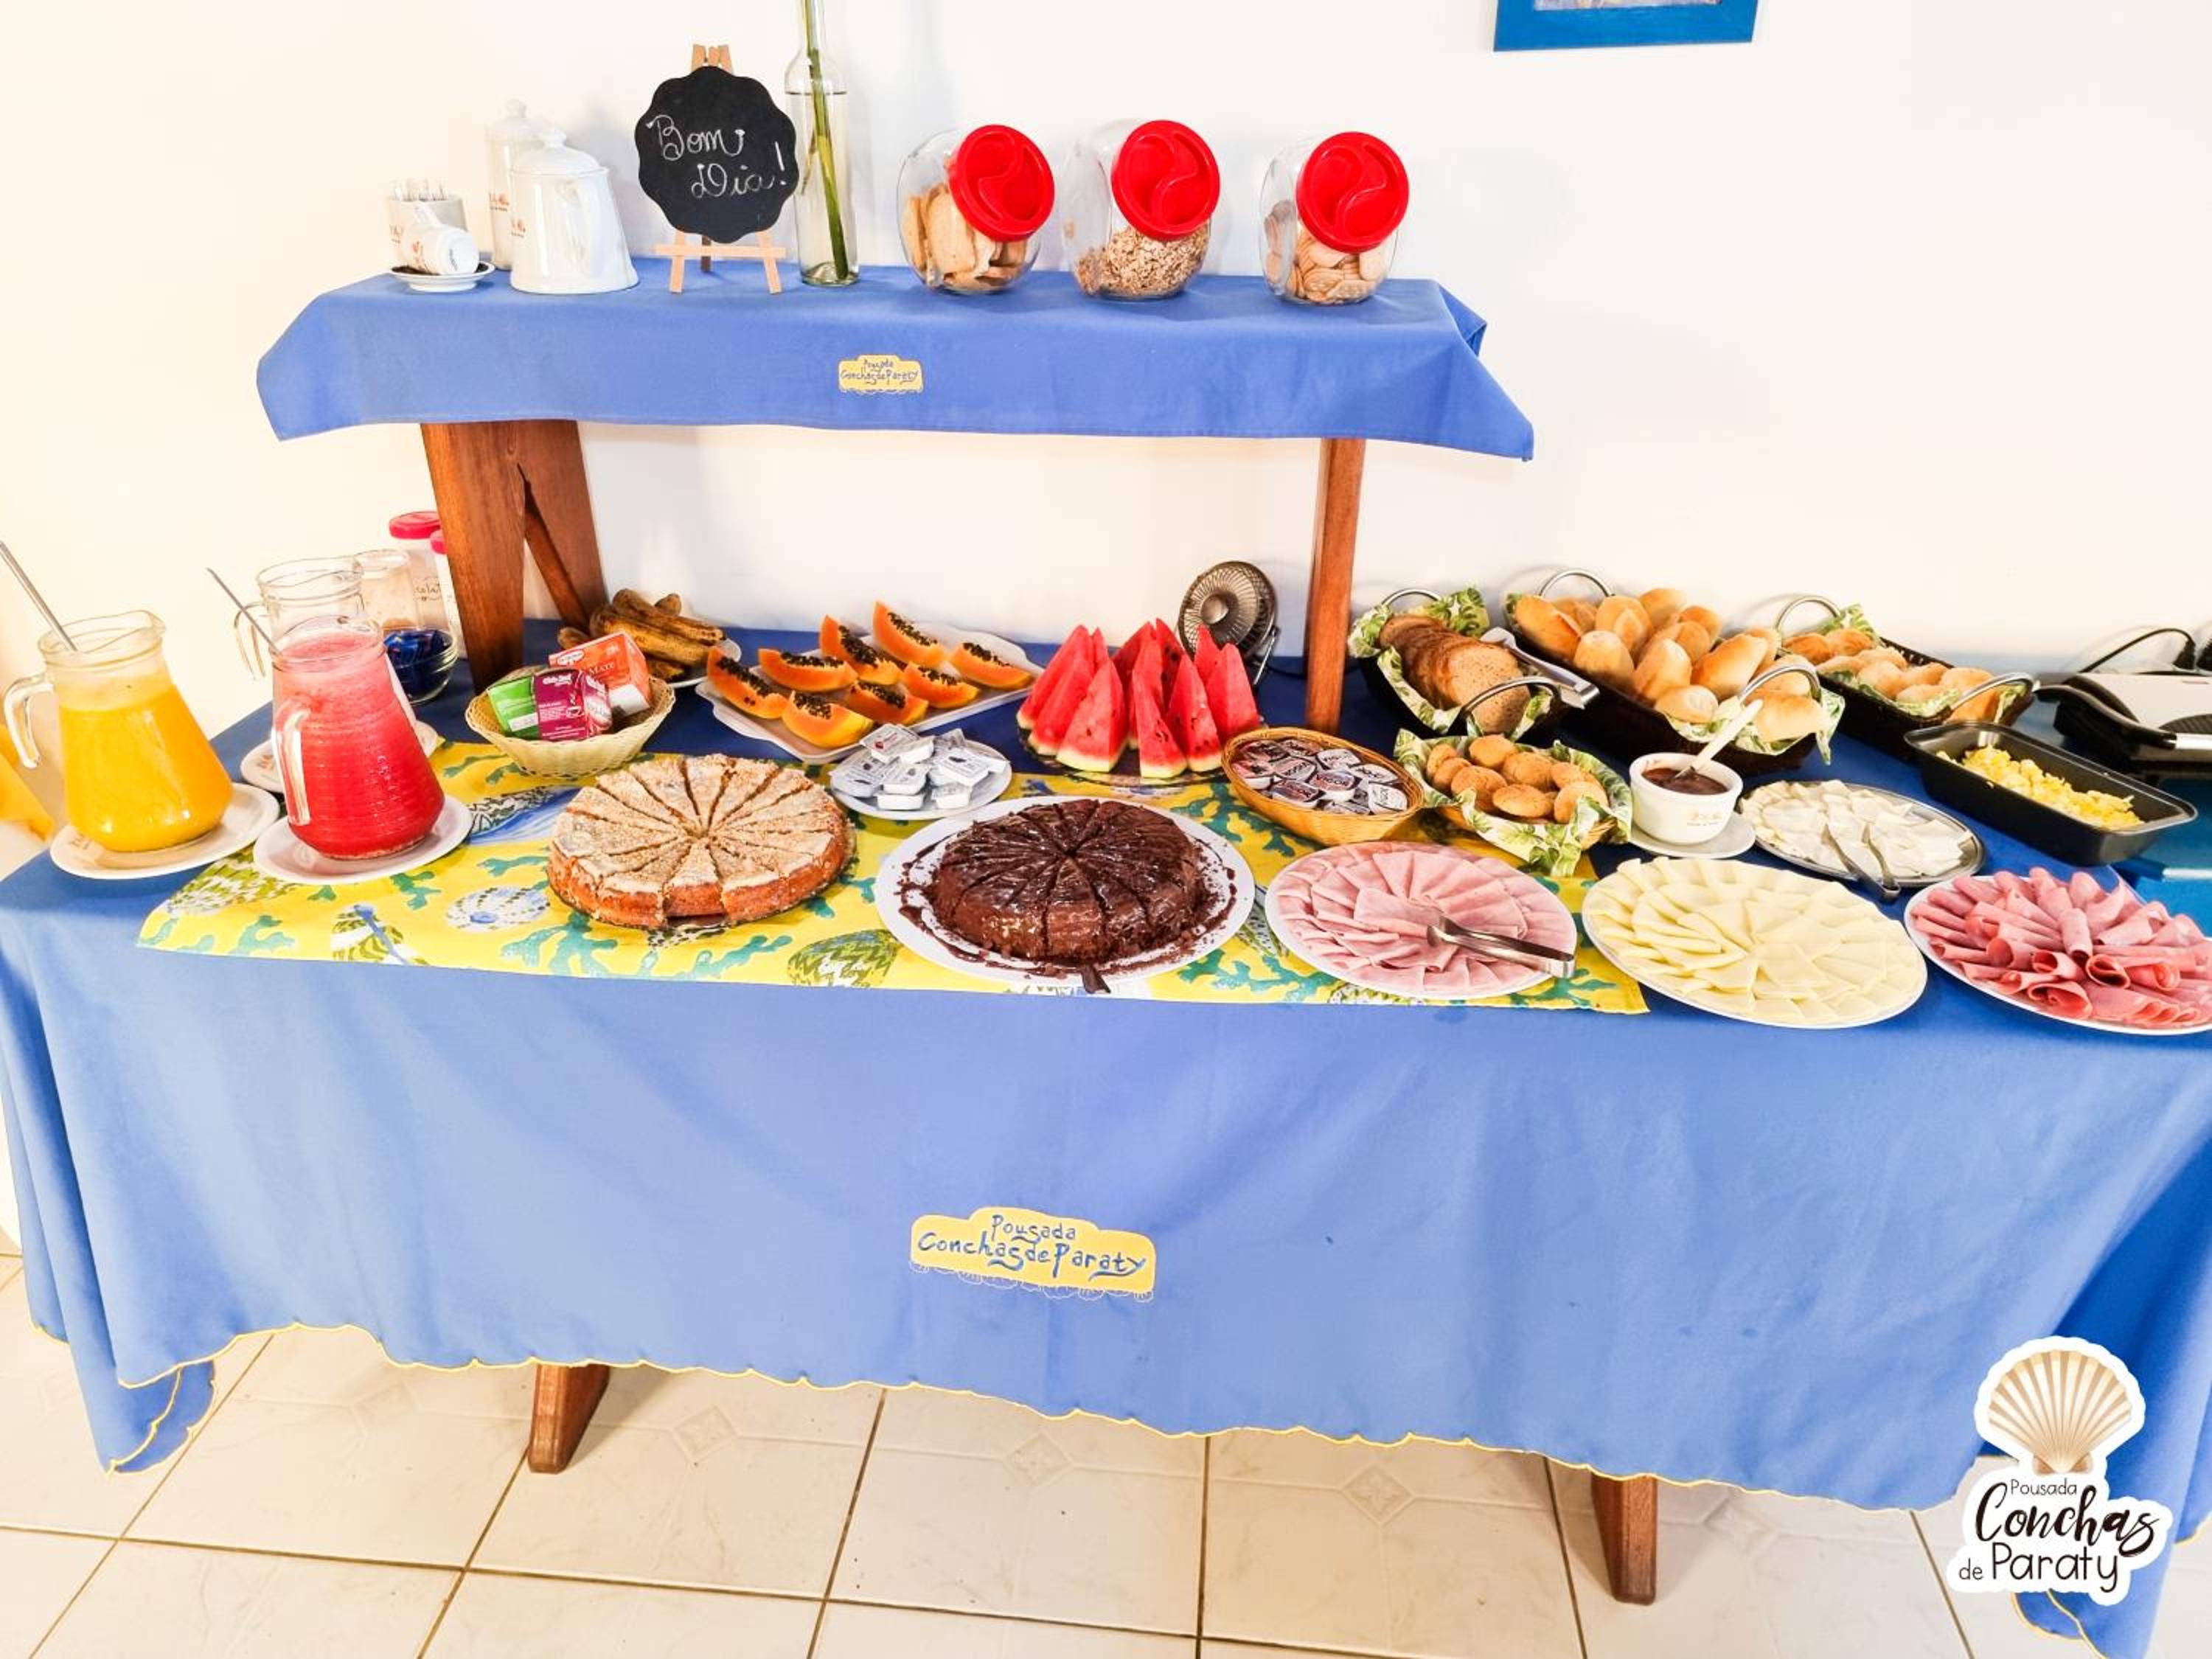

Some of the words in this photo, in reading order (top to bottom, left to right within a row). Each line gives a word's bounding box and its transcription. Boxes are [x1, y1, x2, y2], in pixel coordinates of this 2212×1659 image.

[646, 114, 745, 161] Bom
[691, 141, 787, 199] Dia!
[863, 358, 894, 372] Pousada
[1316, 774, 1348, 787] VIGOR
[991, 1214, 1077, 1244] Pousada
[917, 1231, 1024, 1271] Conchas
[1052, 1242, 1147, 1282] Paraty
